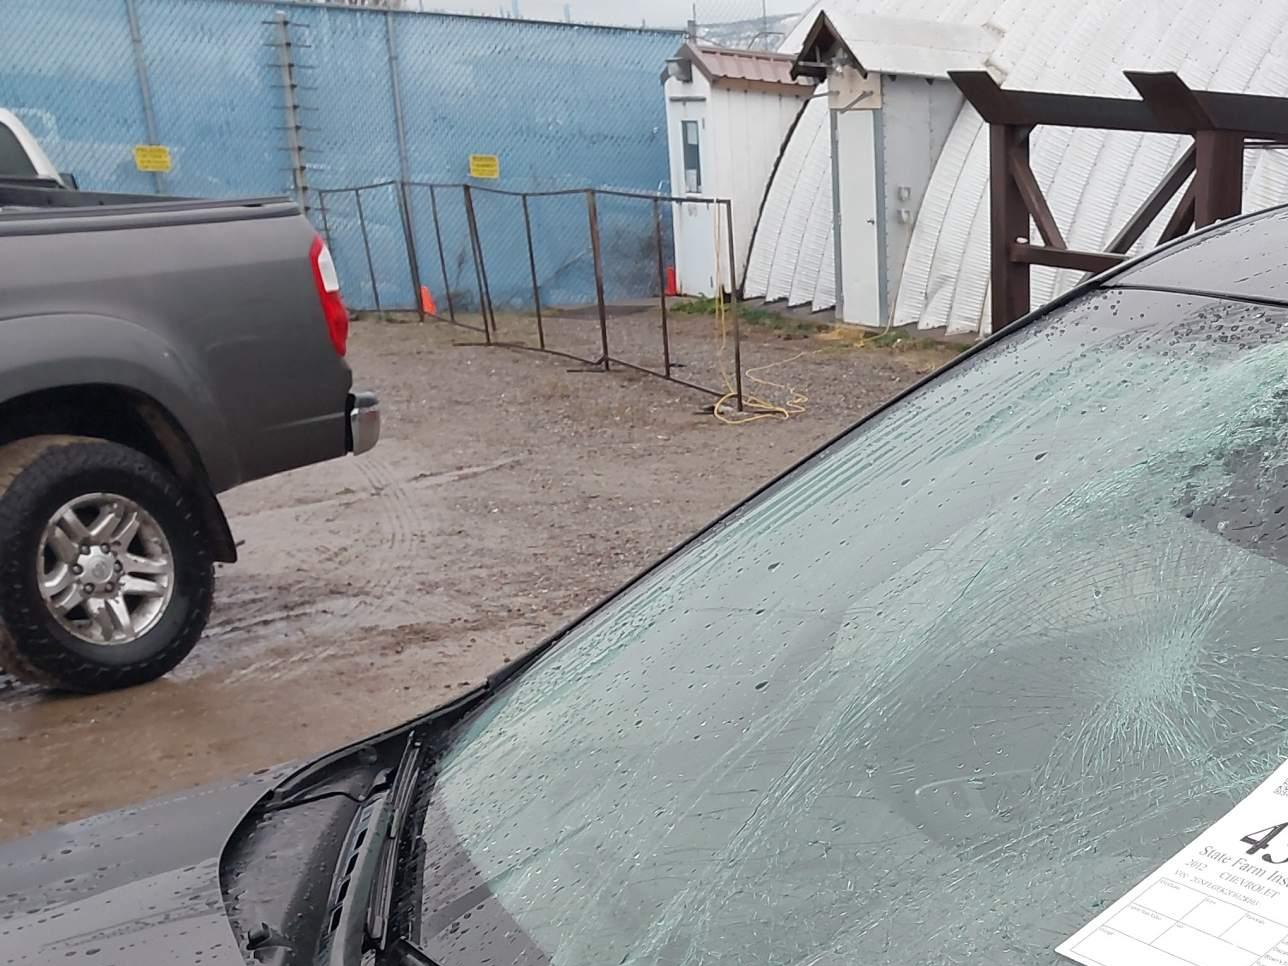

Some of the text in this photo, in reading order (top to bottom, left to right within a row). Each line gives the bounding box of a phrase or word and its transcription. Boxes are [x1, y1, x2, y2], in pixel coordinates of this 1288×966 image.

[1199, 845, 1232, 864] State
[1231, 857, 1267, 878] Farm
[1218, 872, 1281, 899] CHEVROLET
